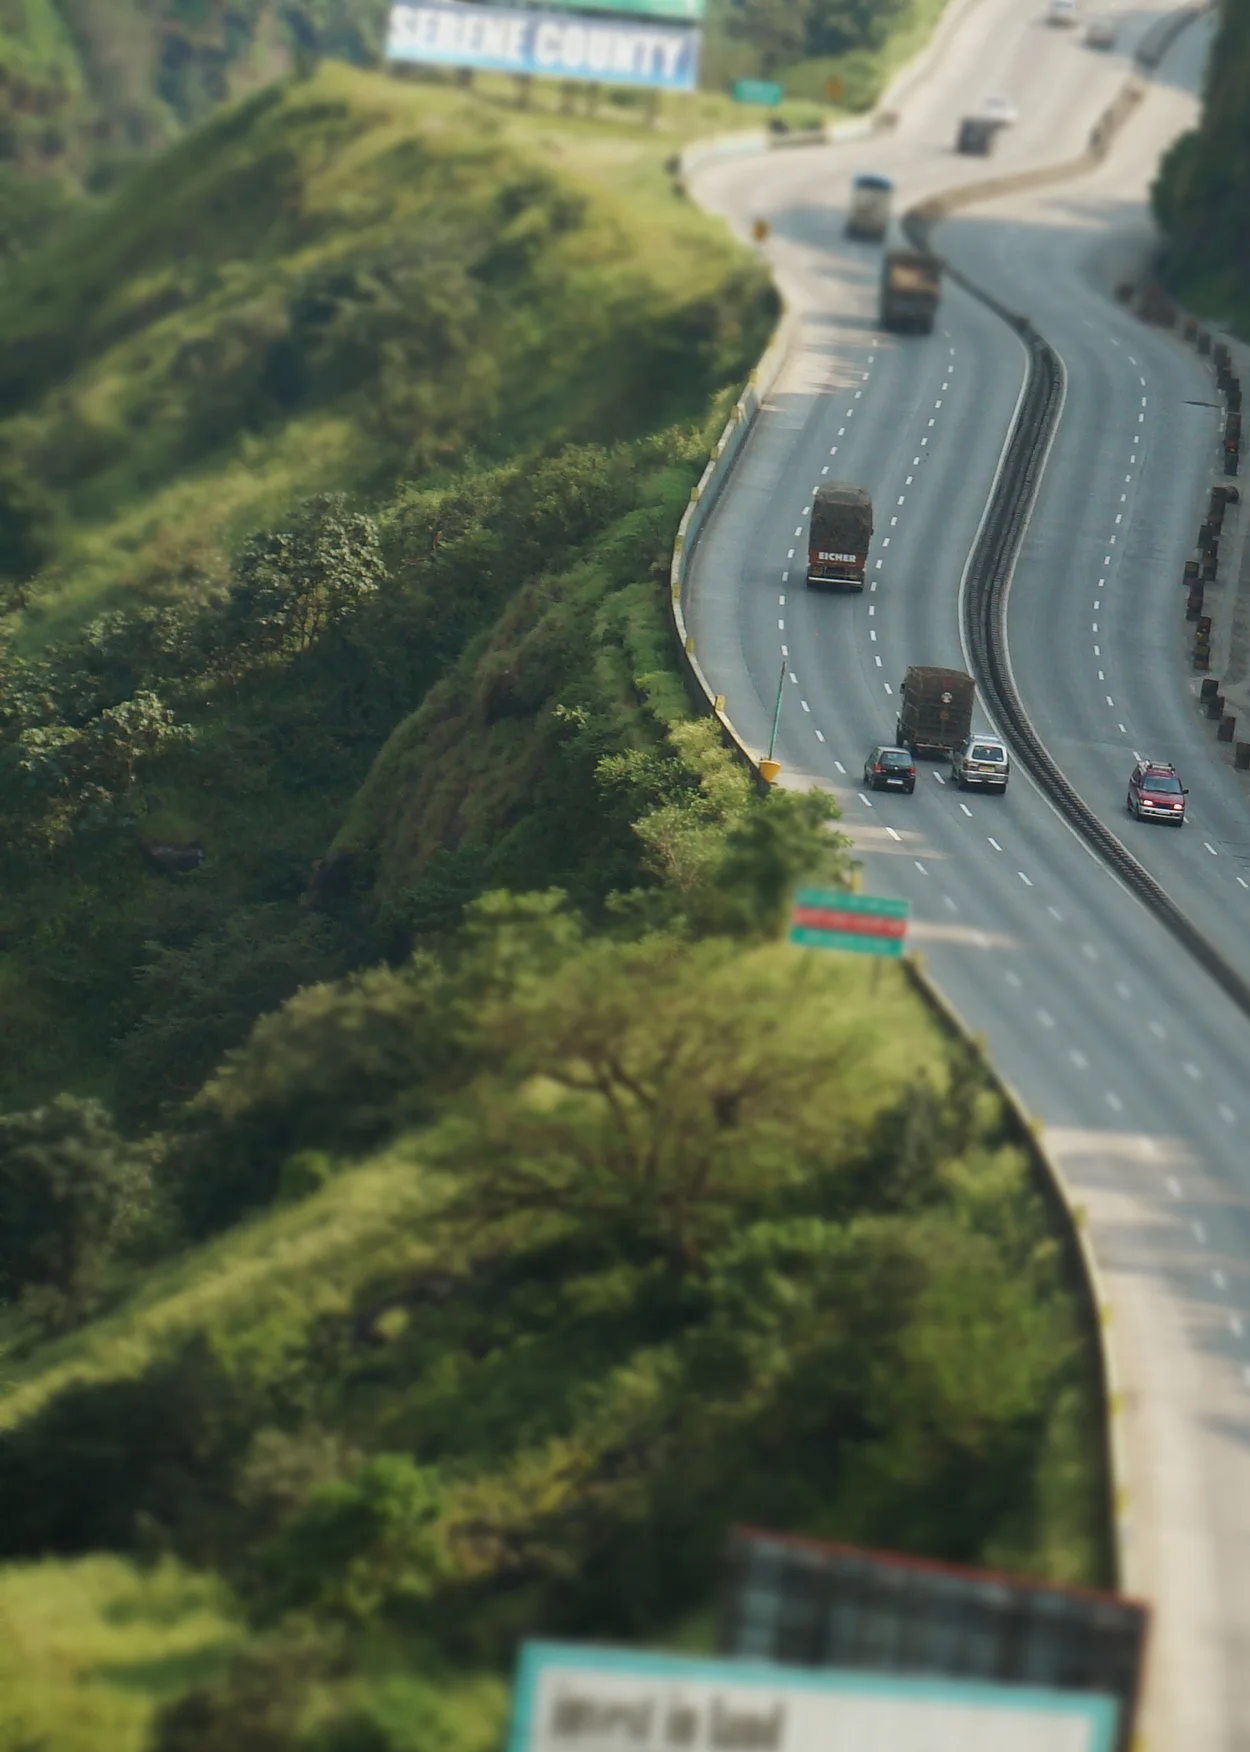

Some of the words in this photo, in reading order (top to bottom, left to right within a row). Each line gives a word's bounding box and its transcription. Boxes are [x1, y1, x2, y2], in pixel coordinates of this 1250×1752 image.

[389, 5, 528, 60] SERENE
[533, 21, 686, 79] COUNTY
[818, 552, 857, 563] EICHER
